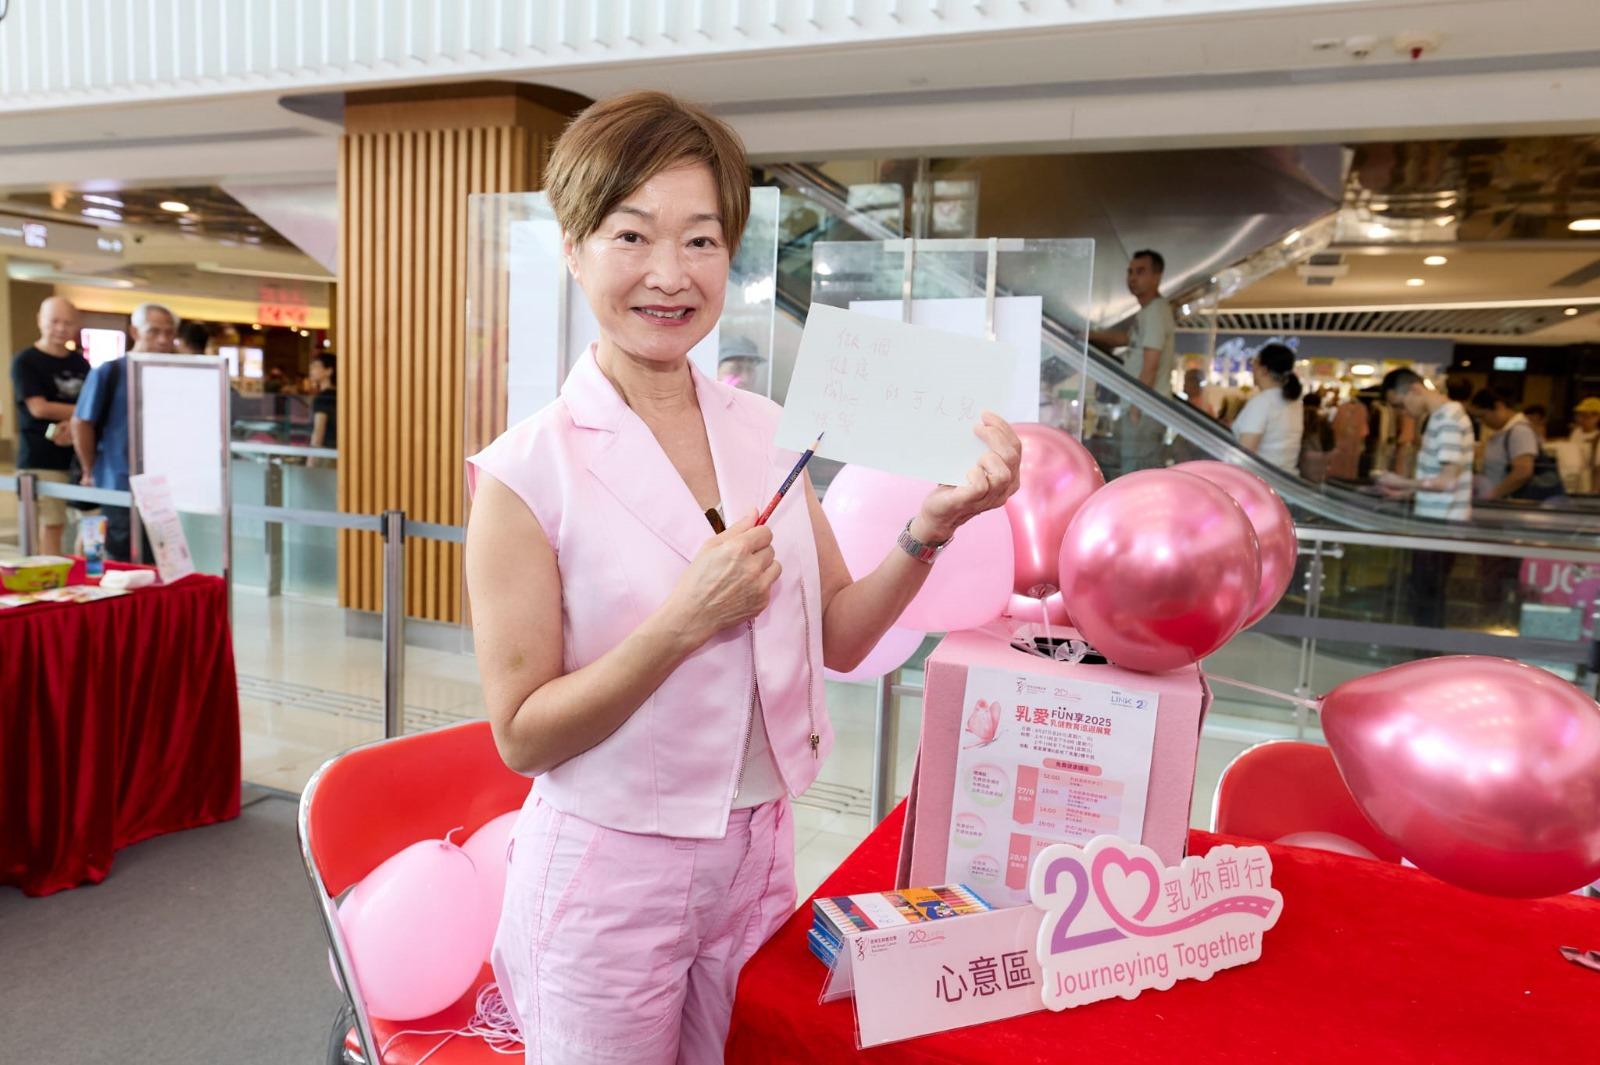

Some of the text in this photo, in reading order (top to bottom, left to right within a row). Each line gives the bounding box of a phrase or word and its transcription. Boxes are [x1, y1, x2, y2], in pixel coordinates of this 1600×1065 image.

[1015, 704, 1050, 726] 乳愛
[1163, 856, 1267, 914] 乳你前行
[934, 949, 1035, 1003] 心意區
[1054, 930, 1257, 998] Journeying Together
